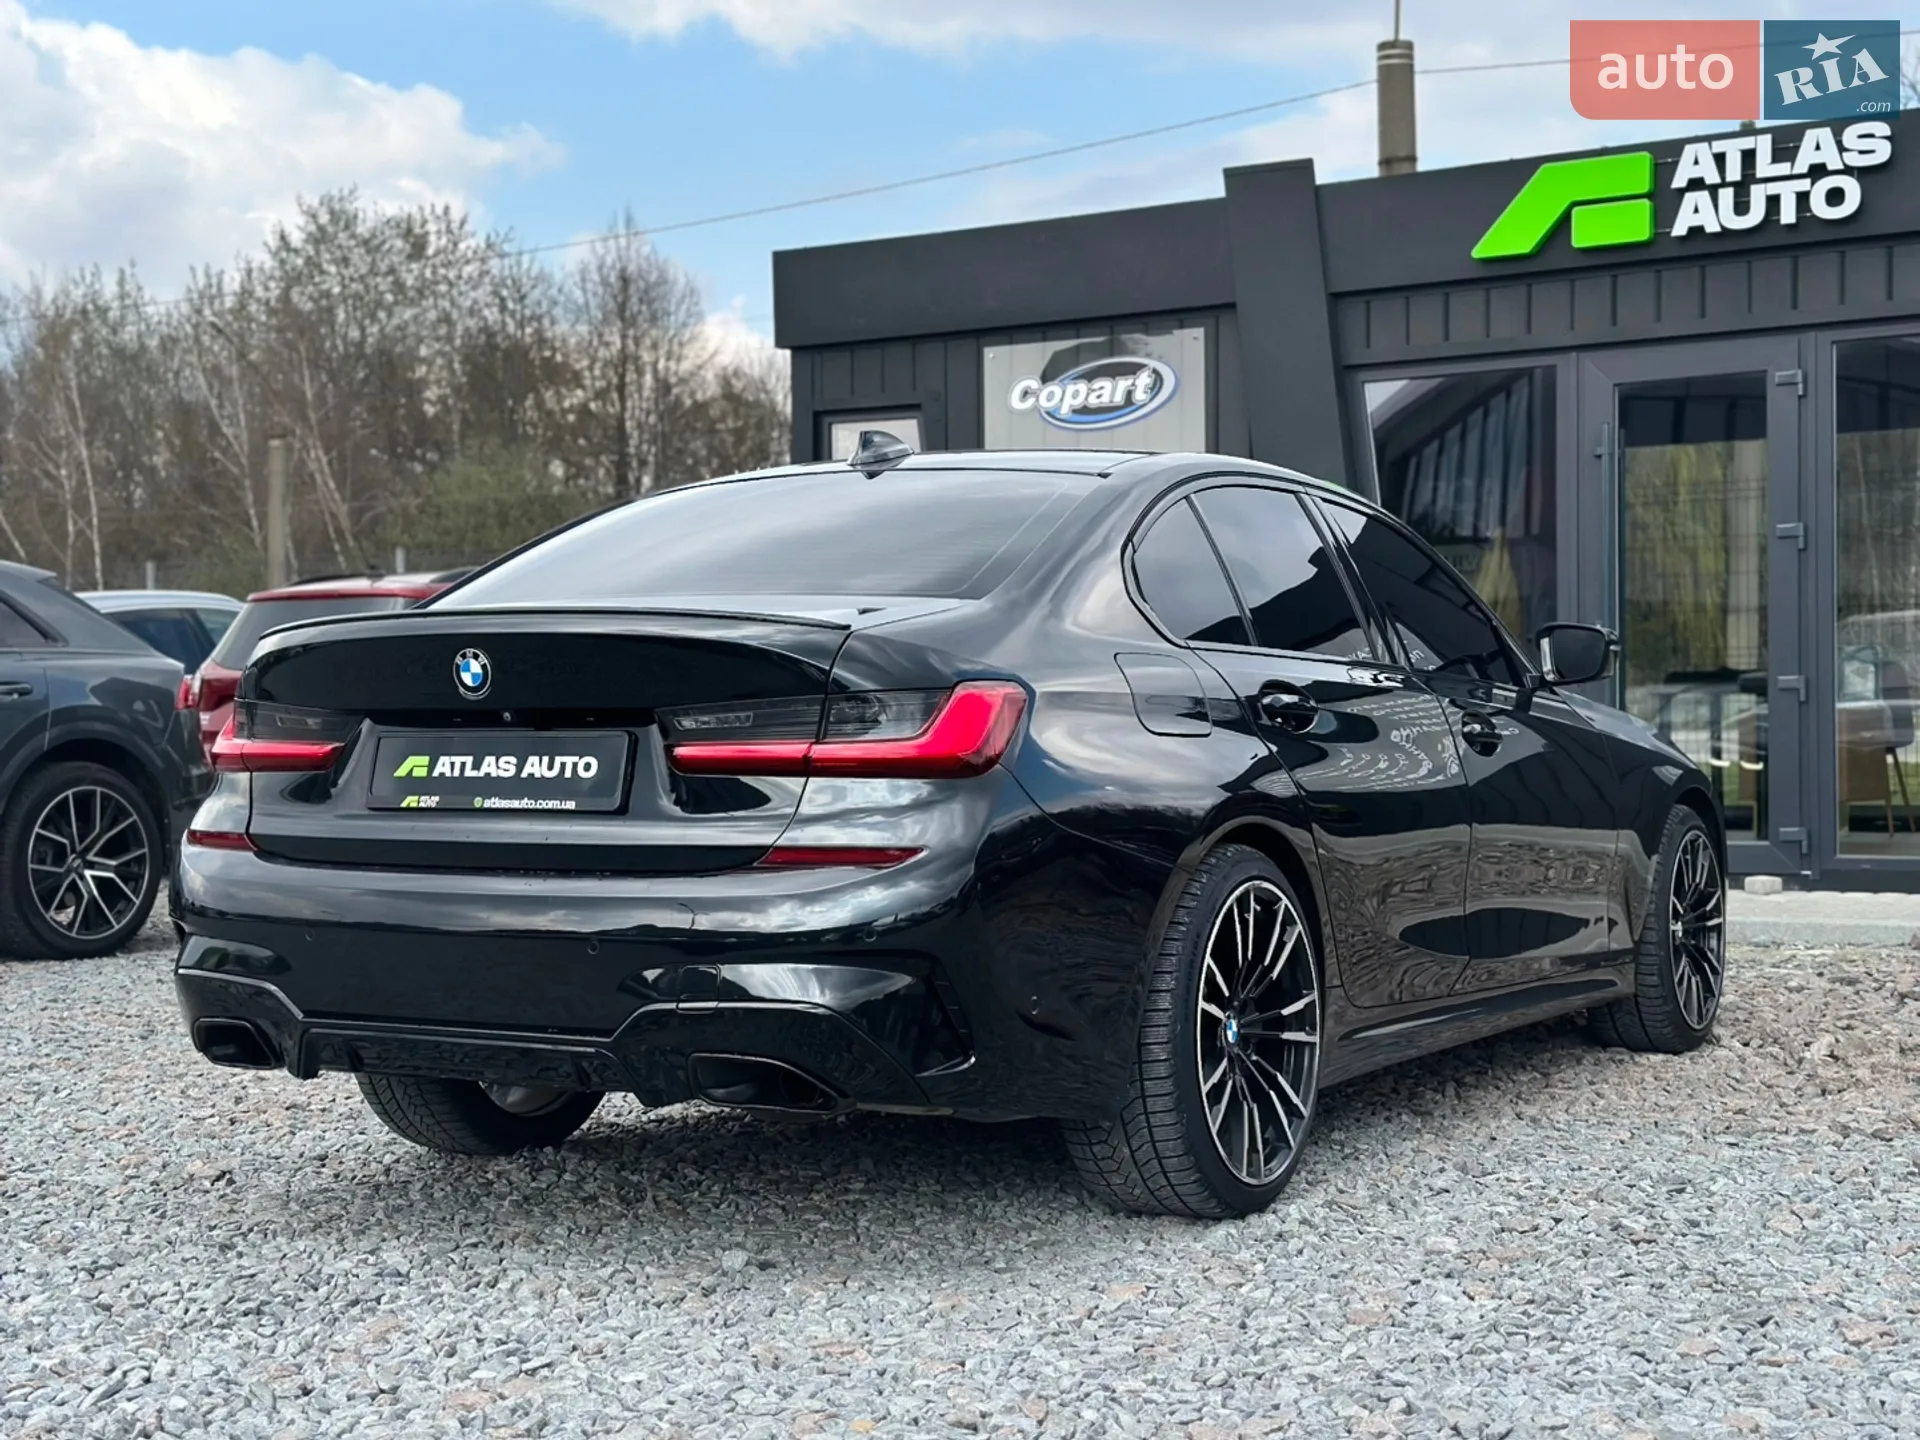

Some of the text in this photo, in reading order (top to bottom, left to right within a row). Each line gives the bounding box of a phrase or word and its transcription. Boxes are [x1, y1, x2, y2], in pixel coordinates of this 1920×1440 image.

[1670, 121, 1893, 190] ATLAS
[1670, 174, 1862, 238] AUTO
[1009, 365, 1156, 416] Copart
[432, 755, 599, 779] ATLAS AUTO
[482, 797, 576, 810] atlasauto.com.ua
